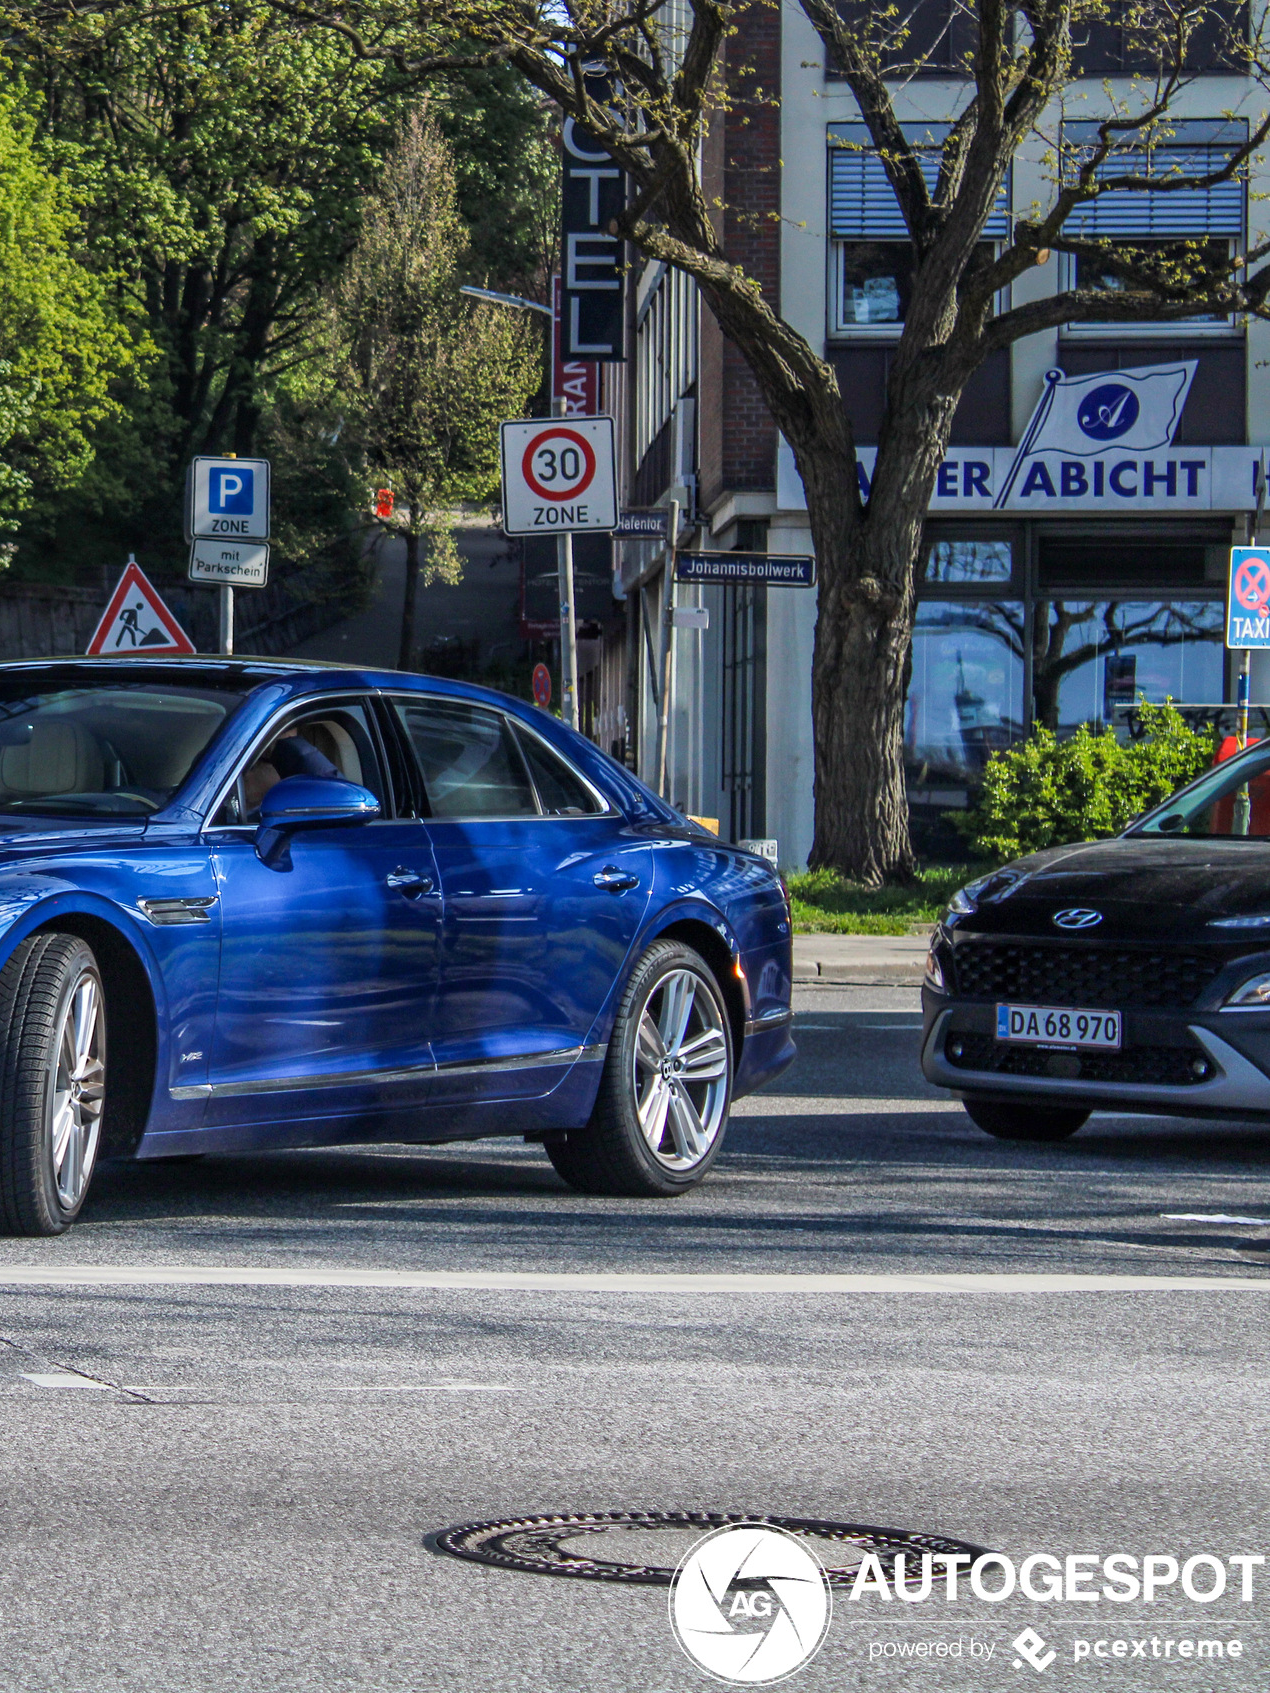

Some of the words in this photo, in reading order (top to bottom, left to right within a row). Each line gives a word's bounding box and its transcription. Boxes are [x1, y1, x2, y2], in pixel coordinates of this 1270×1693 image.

[537, 447, 580, 482] 30
[1021, 460, 1206, 498] ABICHT
[219, 474, 243, 508] P
[533, 505, 589, 526] ZONE
[211, 519, 250, 534] ZONE
[221, 551, 240, 562] mit
[196, 561, 261, 577] Parkschein
[686, 559, 805, 580] Johannisbollwerk
[1233, 617, 1270, 639] TAXI
[1011, 1010, 1040, 1036] DA
[1045, 1012, 1071, 1038] 68
[1077, 1015, 1117, 1041] 970
